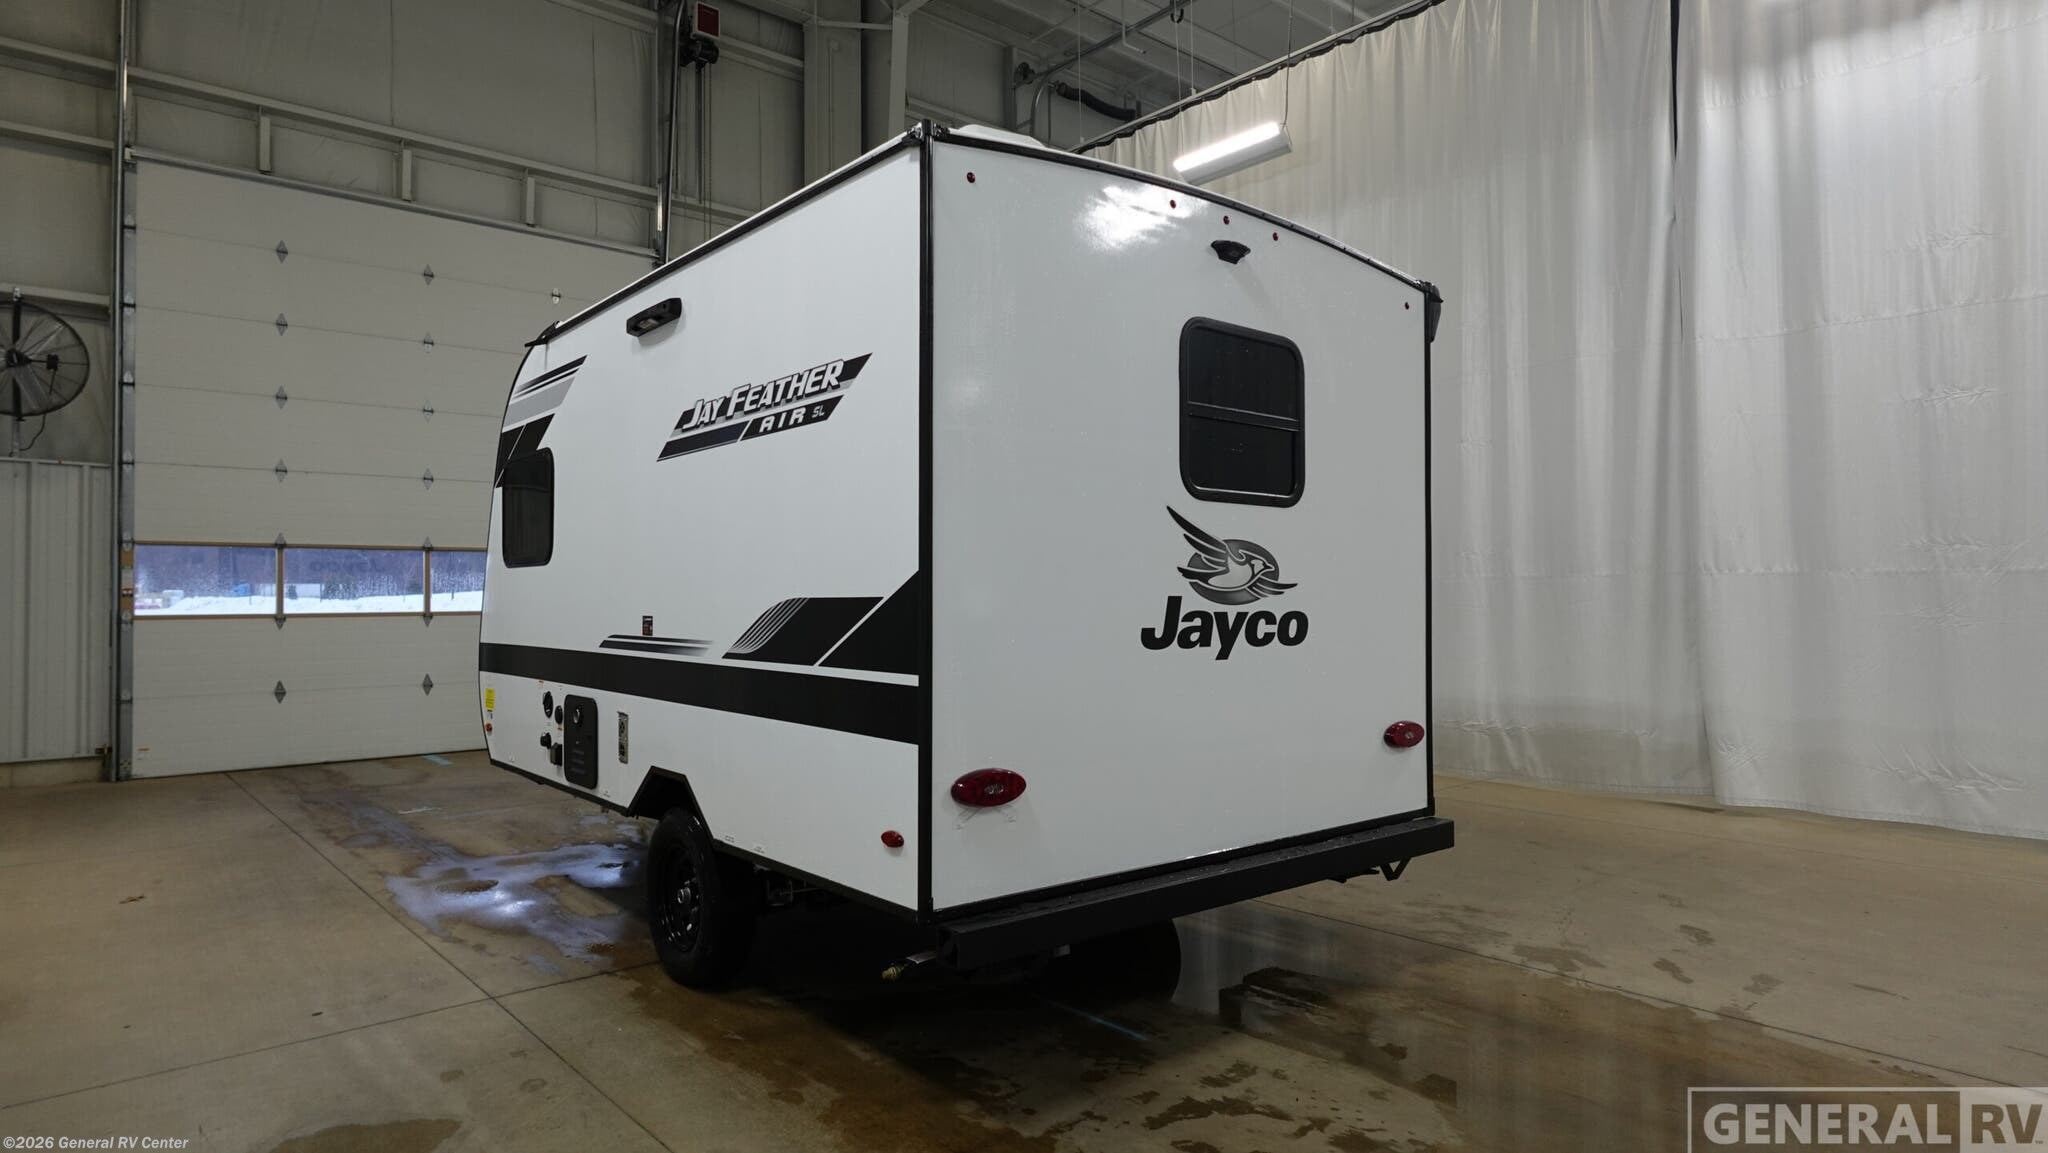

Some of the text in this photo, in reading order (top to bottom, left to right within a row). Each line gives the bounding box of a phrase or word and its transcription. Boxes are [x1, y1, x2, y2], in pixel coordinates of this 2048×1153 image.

[681, 358, 845, 432] JAY FEATHER
[759, 405, 825, 433] AIR SL
[1141, 596, 1308, 661] Jayco
